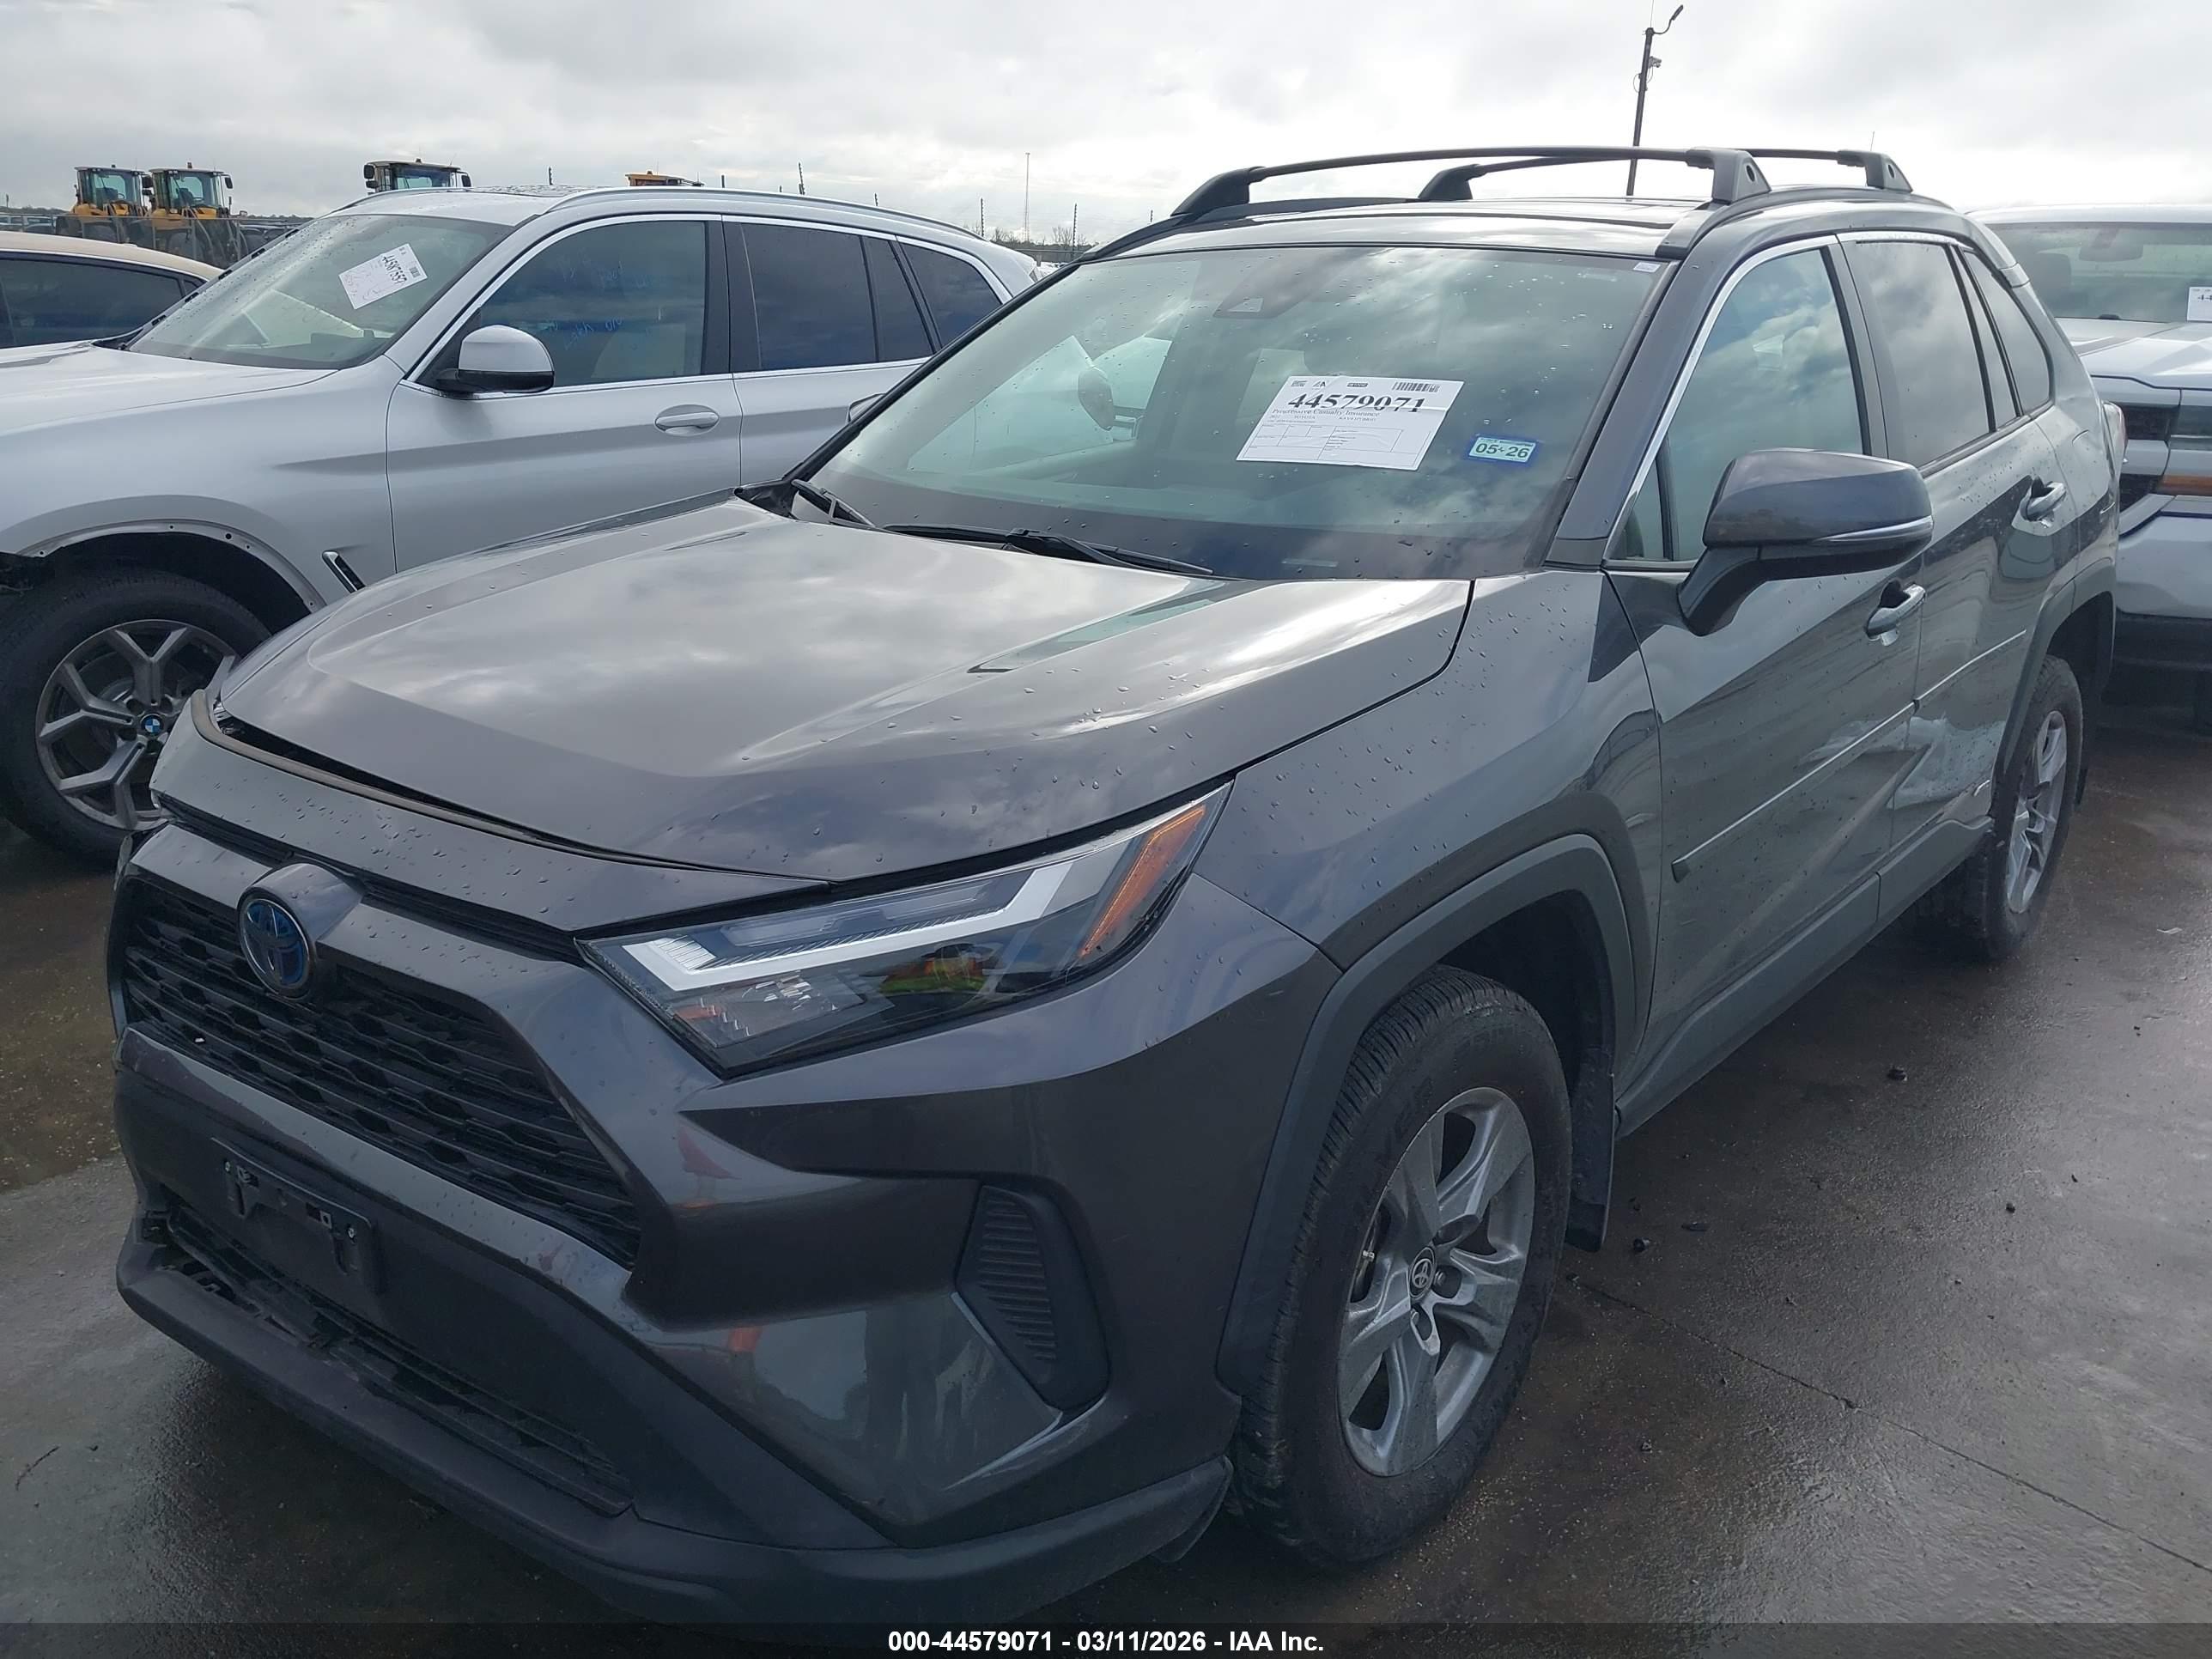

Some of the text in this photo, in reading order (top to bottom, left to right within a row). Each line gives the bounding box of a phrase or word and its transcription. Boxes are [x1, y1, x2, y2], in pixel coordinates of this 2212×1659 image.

[1288, 393, 1425, 413] 44579071
[1475, 443, 1530, 458] 05 26
